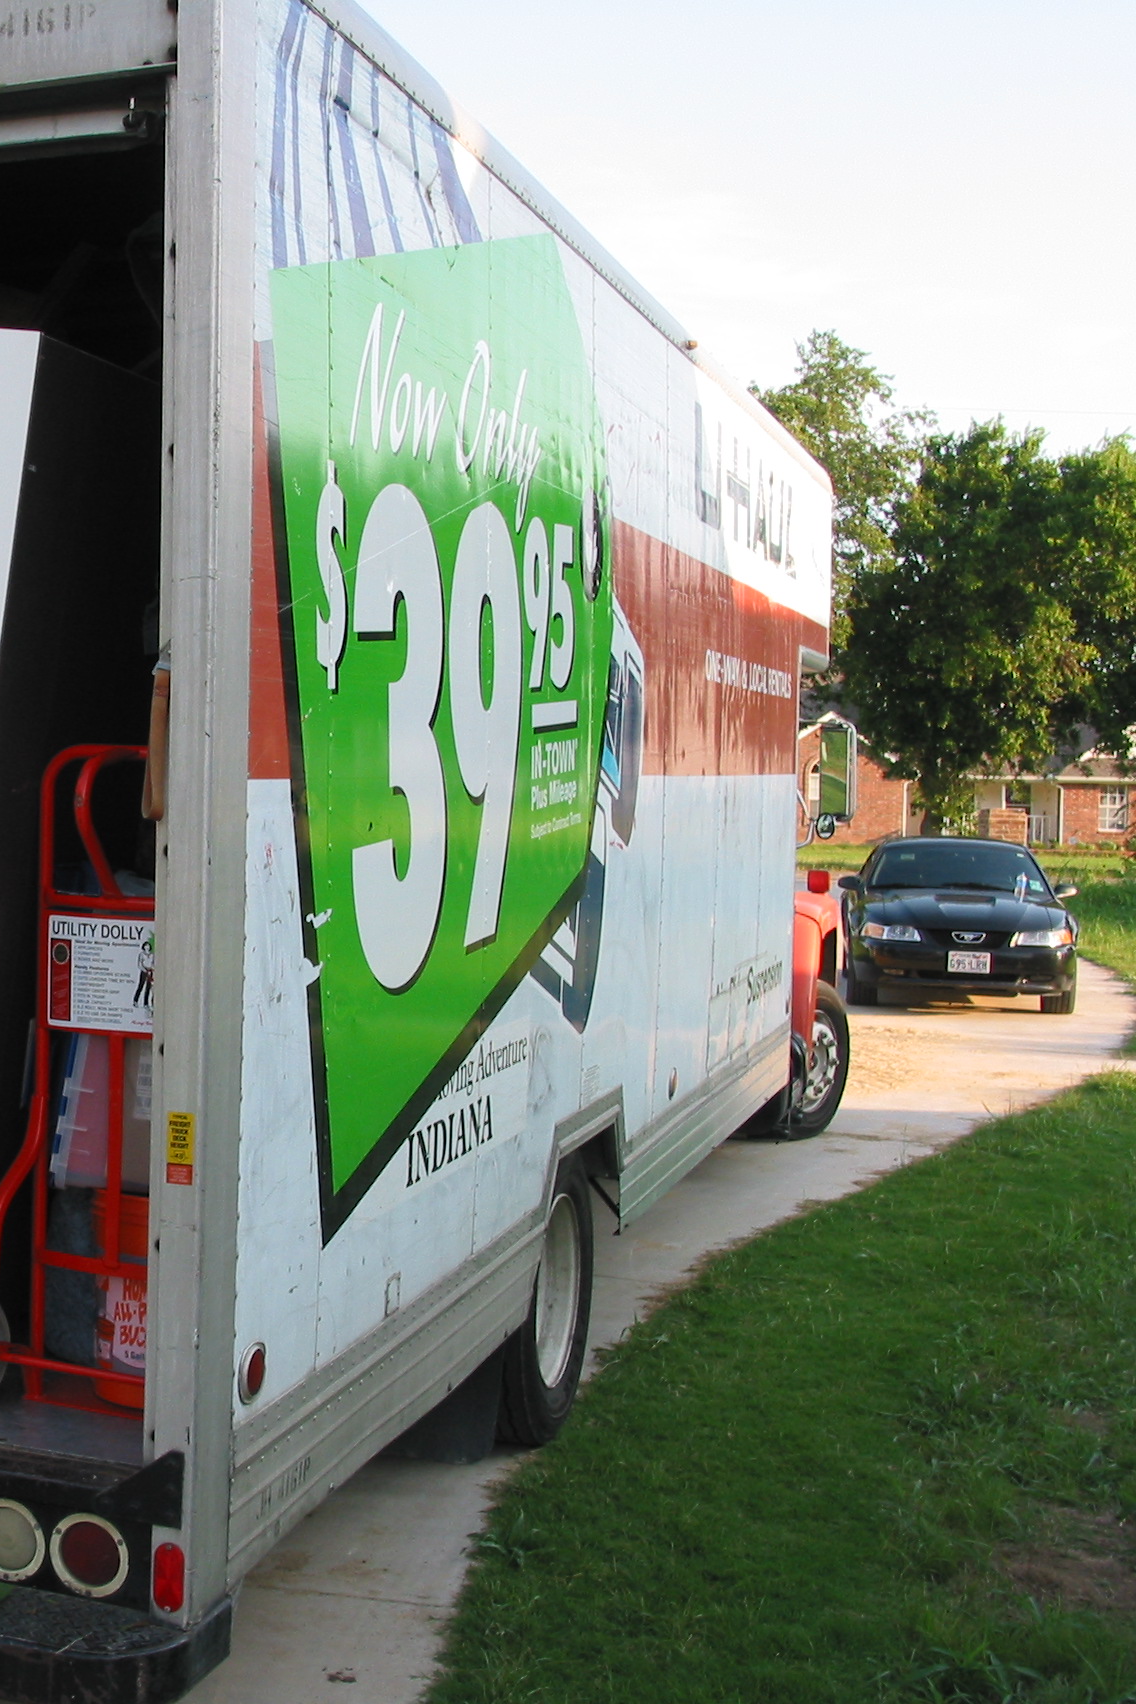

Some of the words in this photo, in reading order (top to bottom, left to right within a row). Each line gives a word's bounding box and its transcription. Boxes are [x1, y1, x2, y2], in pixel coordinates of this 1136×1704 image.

[349, 302, 448, 464] Now
[456, 340, 544, 536] Only
[531, 785, 548, 811] Plus
[549, 780, 577, 805] Mileage
[52, 920, 98, 937] UTILITY
[101, 924, 145, 940] DOLLY
[475, 1036, 529, 1083] Adventure
[405, 1094, 494, 1188] INDIANA
